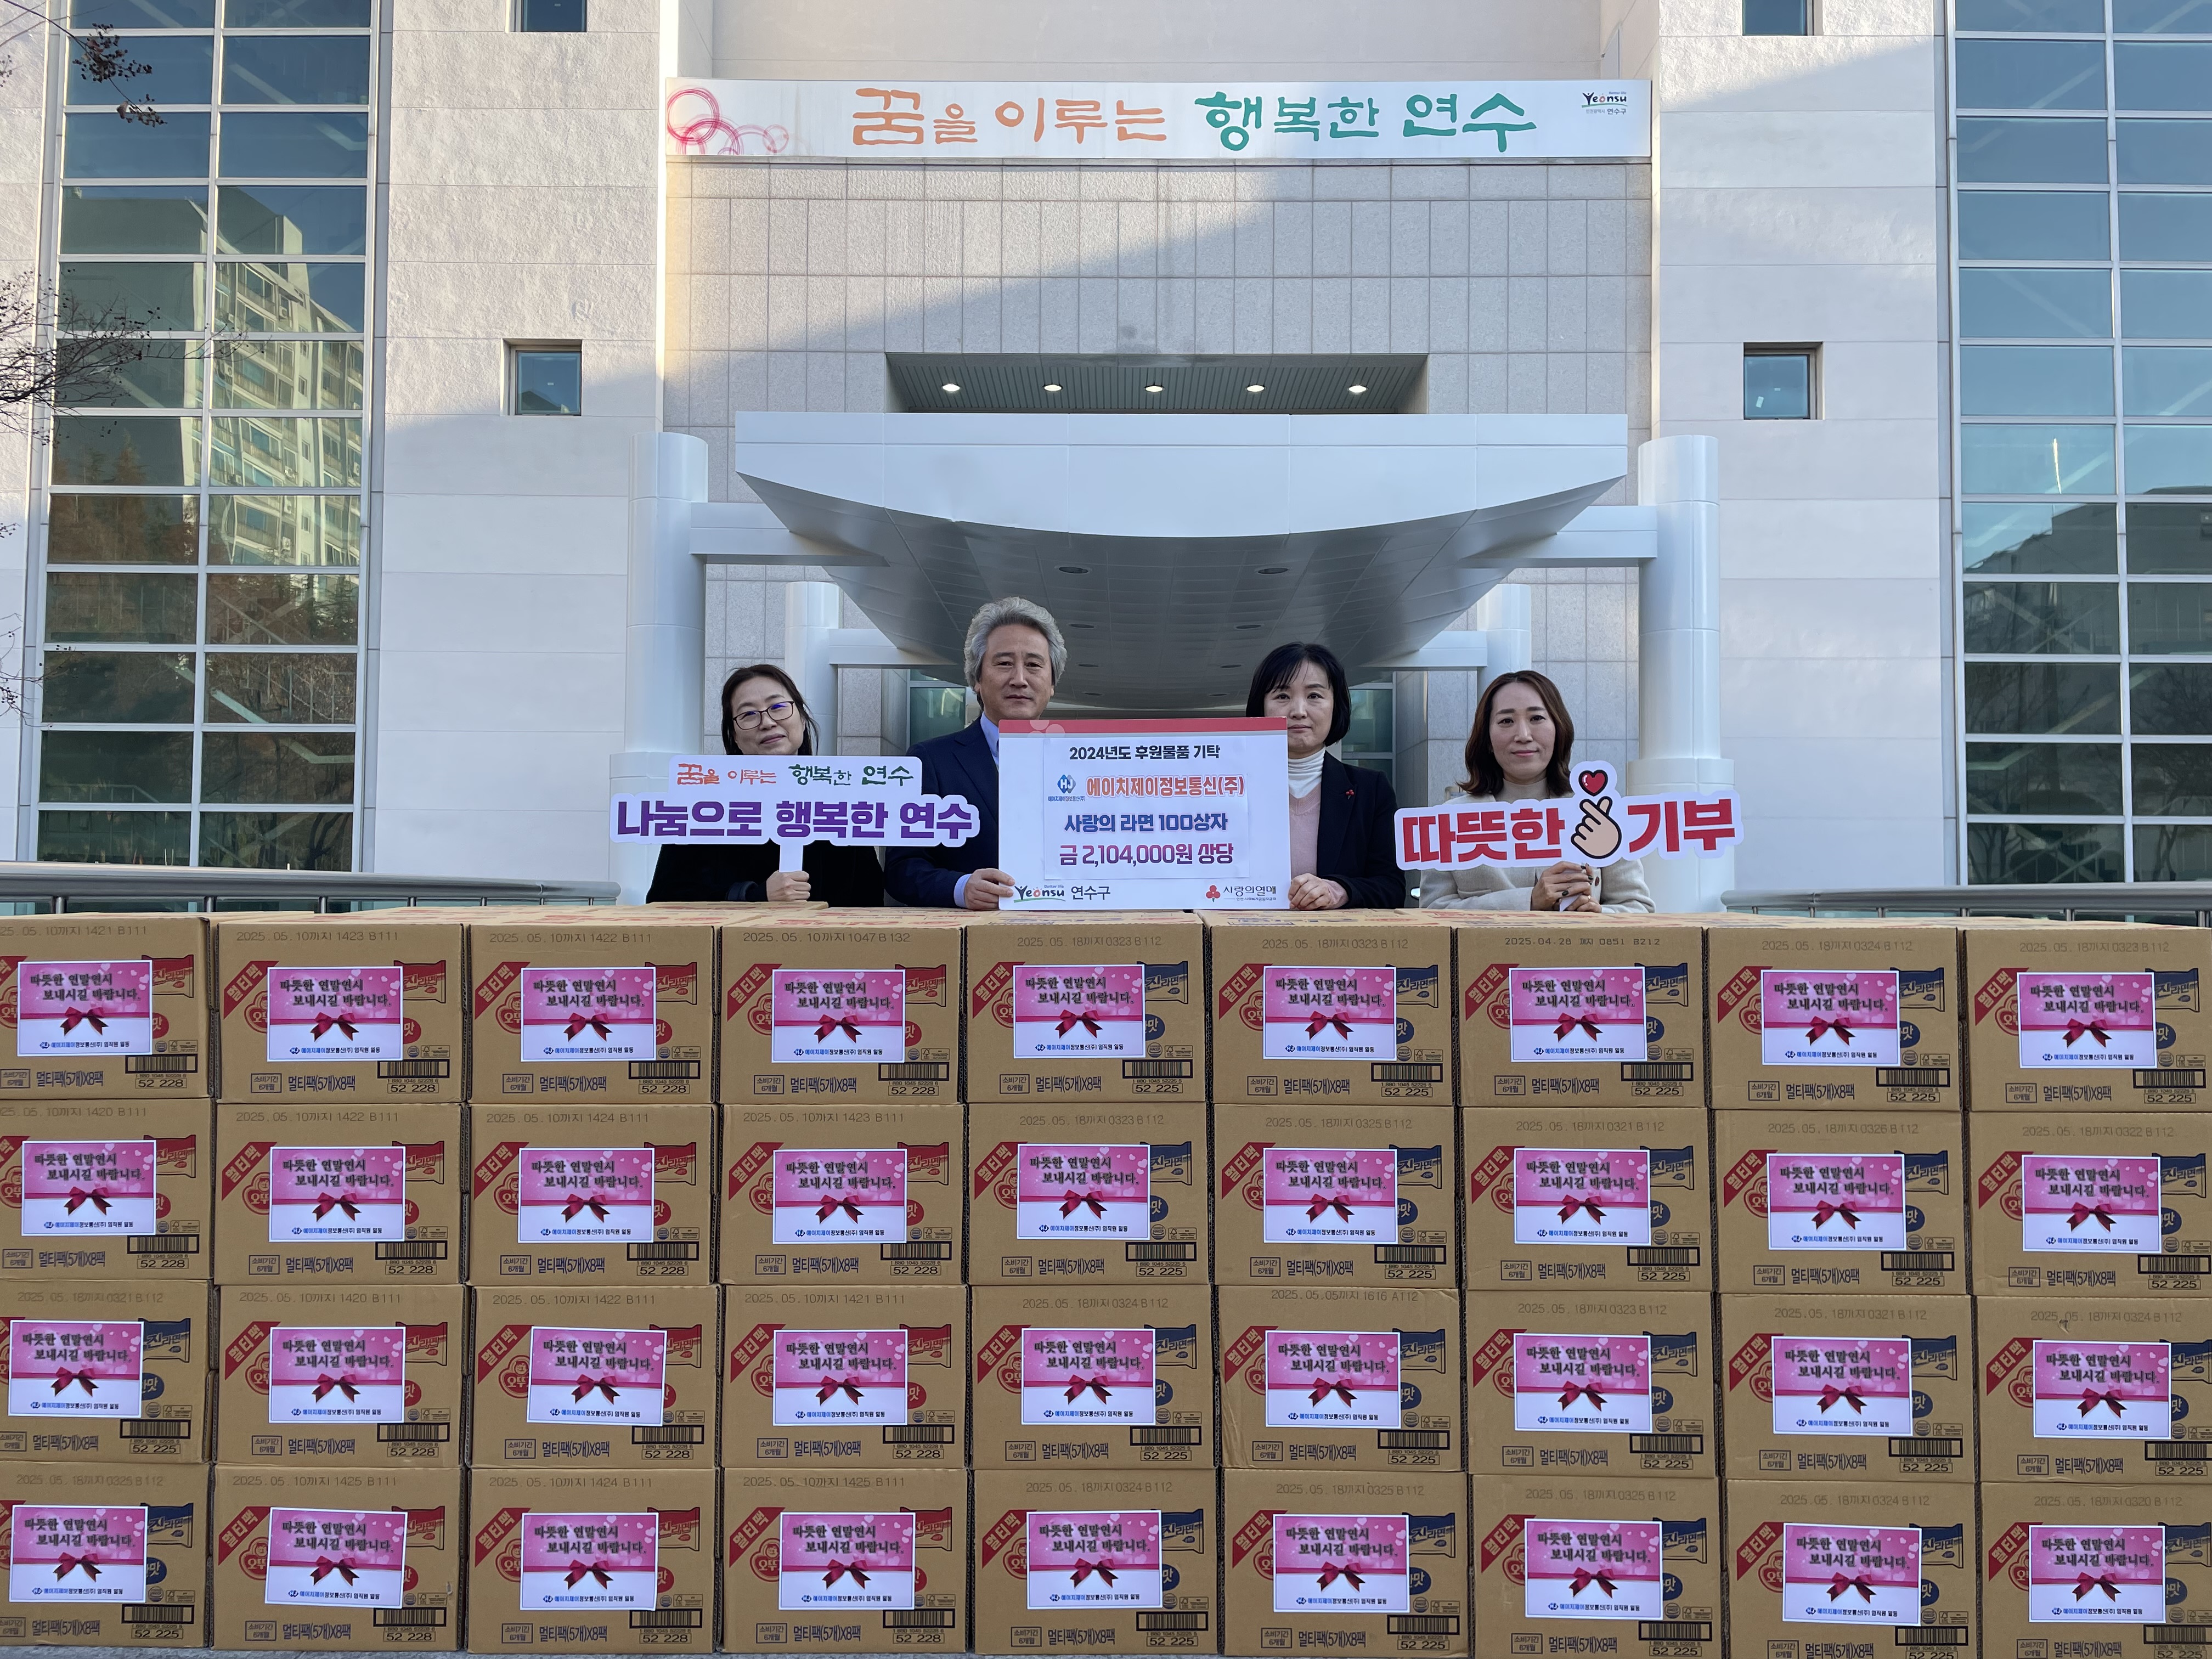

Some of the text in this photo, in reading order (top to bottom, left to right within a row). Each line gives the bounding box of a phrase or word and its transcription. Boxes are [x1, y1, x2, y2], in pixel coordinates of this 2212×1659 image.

[1582, 92, 1627, 105] Yeonsu
[852, 88, 1537, 153] 꿈을 이루는 행복한 연수
[1069, 744, 1221, 760] 2024년도 후원물품 기탁
[677, 763, 914, 787] 꿈을 이루는 행복한 연수
[1060, 778, 1073, 789] HJ
[1087, 776, 1245, 797] 에이치제이정보통신(주)
[617, 800, 972, 839] 나눔으로 행복한 연수
[1064, 813, 1228, 833] 사랑의 라면 100상자
[1402, 798, 1736, 863] 따뜻한 기부
[1059, 843, 1234, 868] 금 2,104,000원 상당
[1014, 885, 1064, 900] Yeonsu
[1071, 885, 1110, 900] 연수구
[86, 926, 146, 935] 1421 B111
[337, 932, 398, 941] 1423 B111
[590, 933, 617, 943] 1422
[623, 933, 652, 943] B111
[30, 974, 112, 985] 따뜻한 연말연시
[1025, 977, 1107, 989] 따뜻한 연말연시
[43, 988, 140, 1000] 보내시길 바랍니다.
[1774, 982, 1858, 995] 따뜻한 연말연시
[1039, 991, 1135, 1004] 보내시길 바랍니다.
[1787, 997, 1887, 1011] 보내시길 바랍니다.
[289, 1075, 355, 1092] 멀티팩(5개)X8팩
[791, 1076, 856, 1093] 멀티팩(5개)X8팩
[1284, 1078, 1350, 1094] 멀티팩(5개)X8팩
[2044, 1085, 2112, 1102] 멀티팩(5개)X8팩
[87, 1108, 146, 1116] 1420 B111
[337, 1112, 364, 1121] 1422
[370, 1112, 398, 1121] B111
[588, 1114, 648, 1122] 1424 B111
[843, 1113, 904, 1122] 1423 B111
[531, 1160, 614, 1172] 따뜻한 연말연시
[1276, 1161, 1358, 1173] 따뜻한 연말연시
[2035, 1167, 2119, 1181] 따뜻한 연말연시
[545, 1175, 642, 1188] 보내시길 바랍니다.
[1289, 1176, 1387, 1189] 보내시길 바랍니다.
[2049, 1182, 2149, 1197] 보내시길 바랍니다.
[39, 1250, 105, 1267] 멀티팩(5개)X8팩
[1039, 1258, 1104, 1275] 멀티팩(5개)X8팩
[1538, 1262, 1605, 1279] 멀티팩(5개)X8팩
[341, 1293, 400, 1303] 1420 B111
[594, 1295, 621, 1305] 1422
[627, 1295, 655, 1305] B111
[844, 1294, 905, 1304] 1421 B111
[1364, 1291, 1418, 1302] 1616 A112
[786, 1342, 868, 1355] 따뜻한 연말연시
[1526, 1346, 1610, 1360] 따뜻한 연말연시
[799, 1357, 896, 1370] 보내시길 바랍니다.
[1540, 1361, 1639, 1376] 보내시길 바랍니다.
[543, 1441, 610, 1458] 멀티팩(5개)X8팩
[1798, 1452, 1866, 1470] 멀티팩(5개)X8팩
[335, 1476, 397, 1486] 1425 B111
[591, 1478, 652, 1487] 1424 B111
[843, 1477, 905, 1487] 1425 B111
[1039, 1525, 1121, 1537] 따뜻한 연말연시
[1052, 1539, 1150, 1551] 보내시길 바랍니다.
[1797, 1536, 1881, 1552] 따뜻한 연말연시
[1810, 1552, 1910, 1568] 보내시길 바랍니다.
